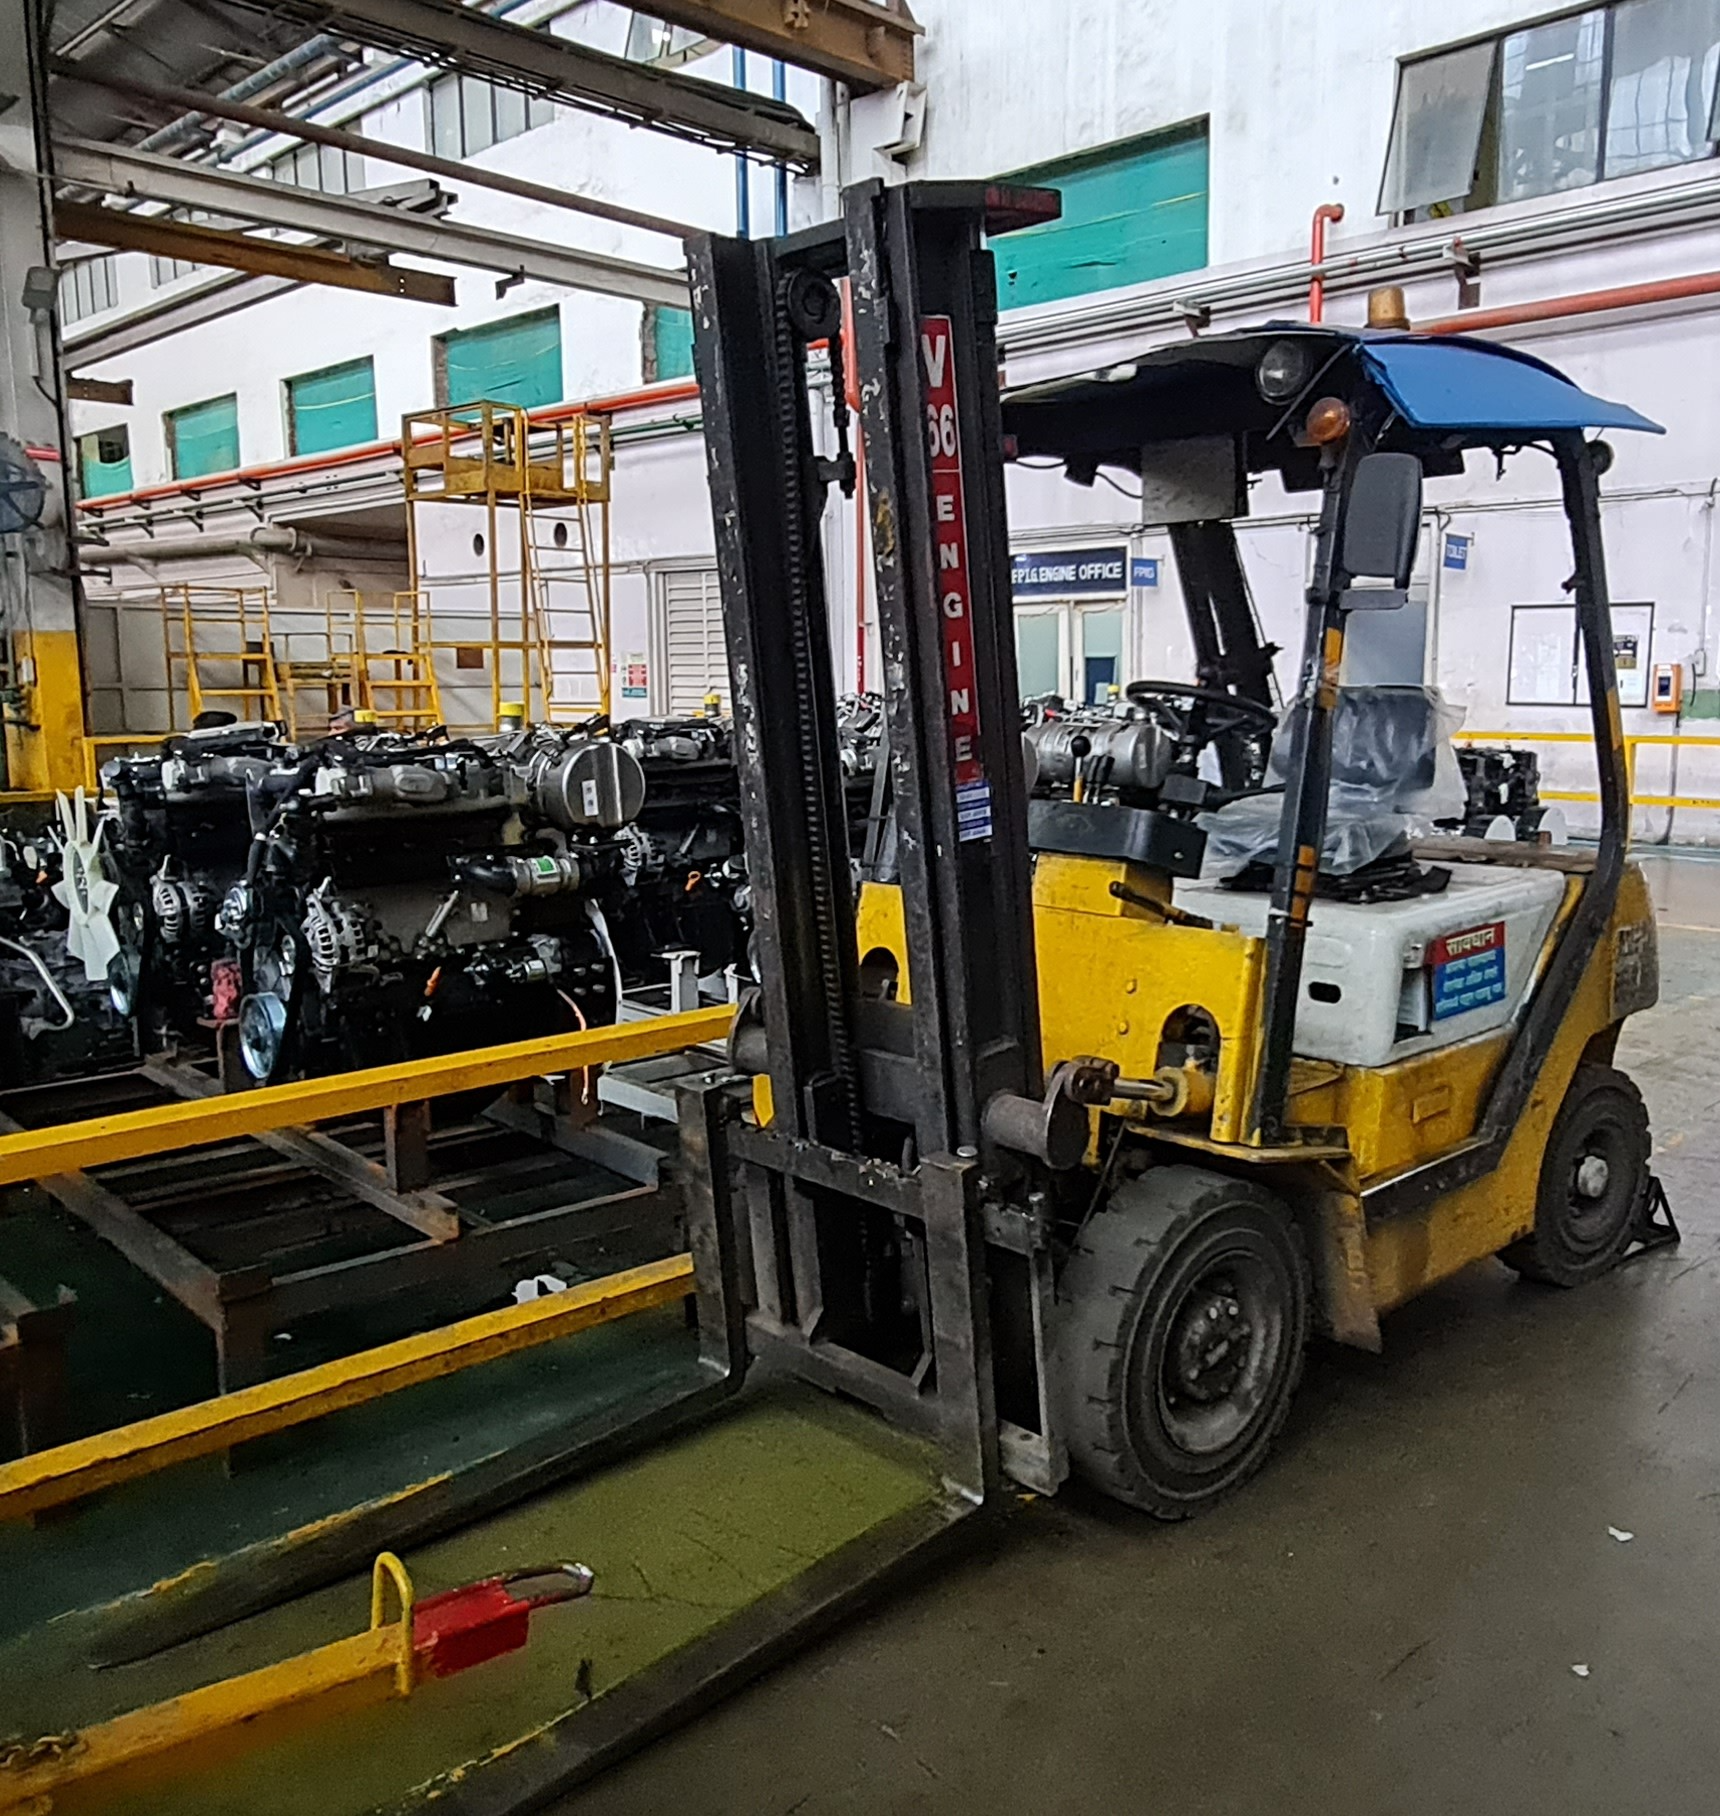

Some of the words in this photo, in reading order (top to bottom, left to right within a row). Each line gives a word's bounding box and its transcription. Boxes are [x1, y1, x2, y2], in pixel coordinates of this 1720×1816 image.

[921, 334, 946, 388] V
[936, 494, 973, 762] ENGINE
[1039, 565, 1076, 582] ENGINE
[1078, 561, 1123, 579] OFFICE
